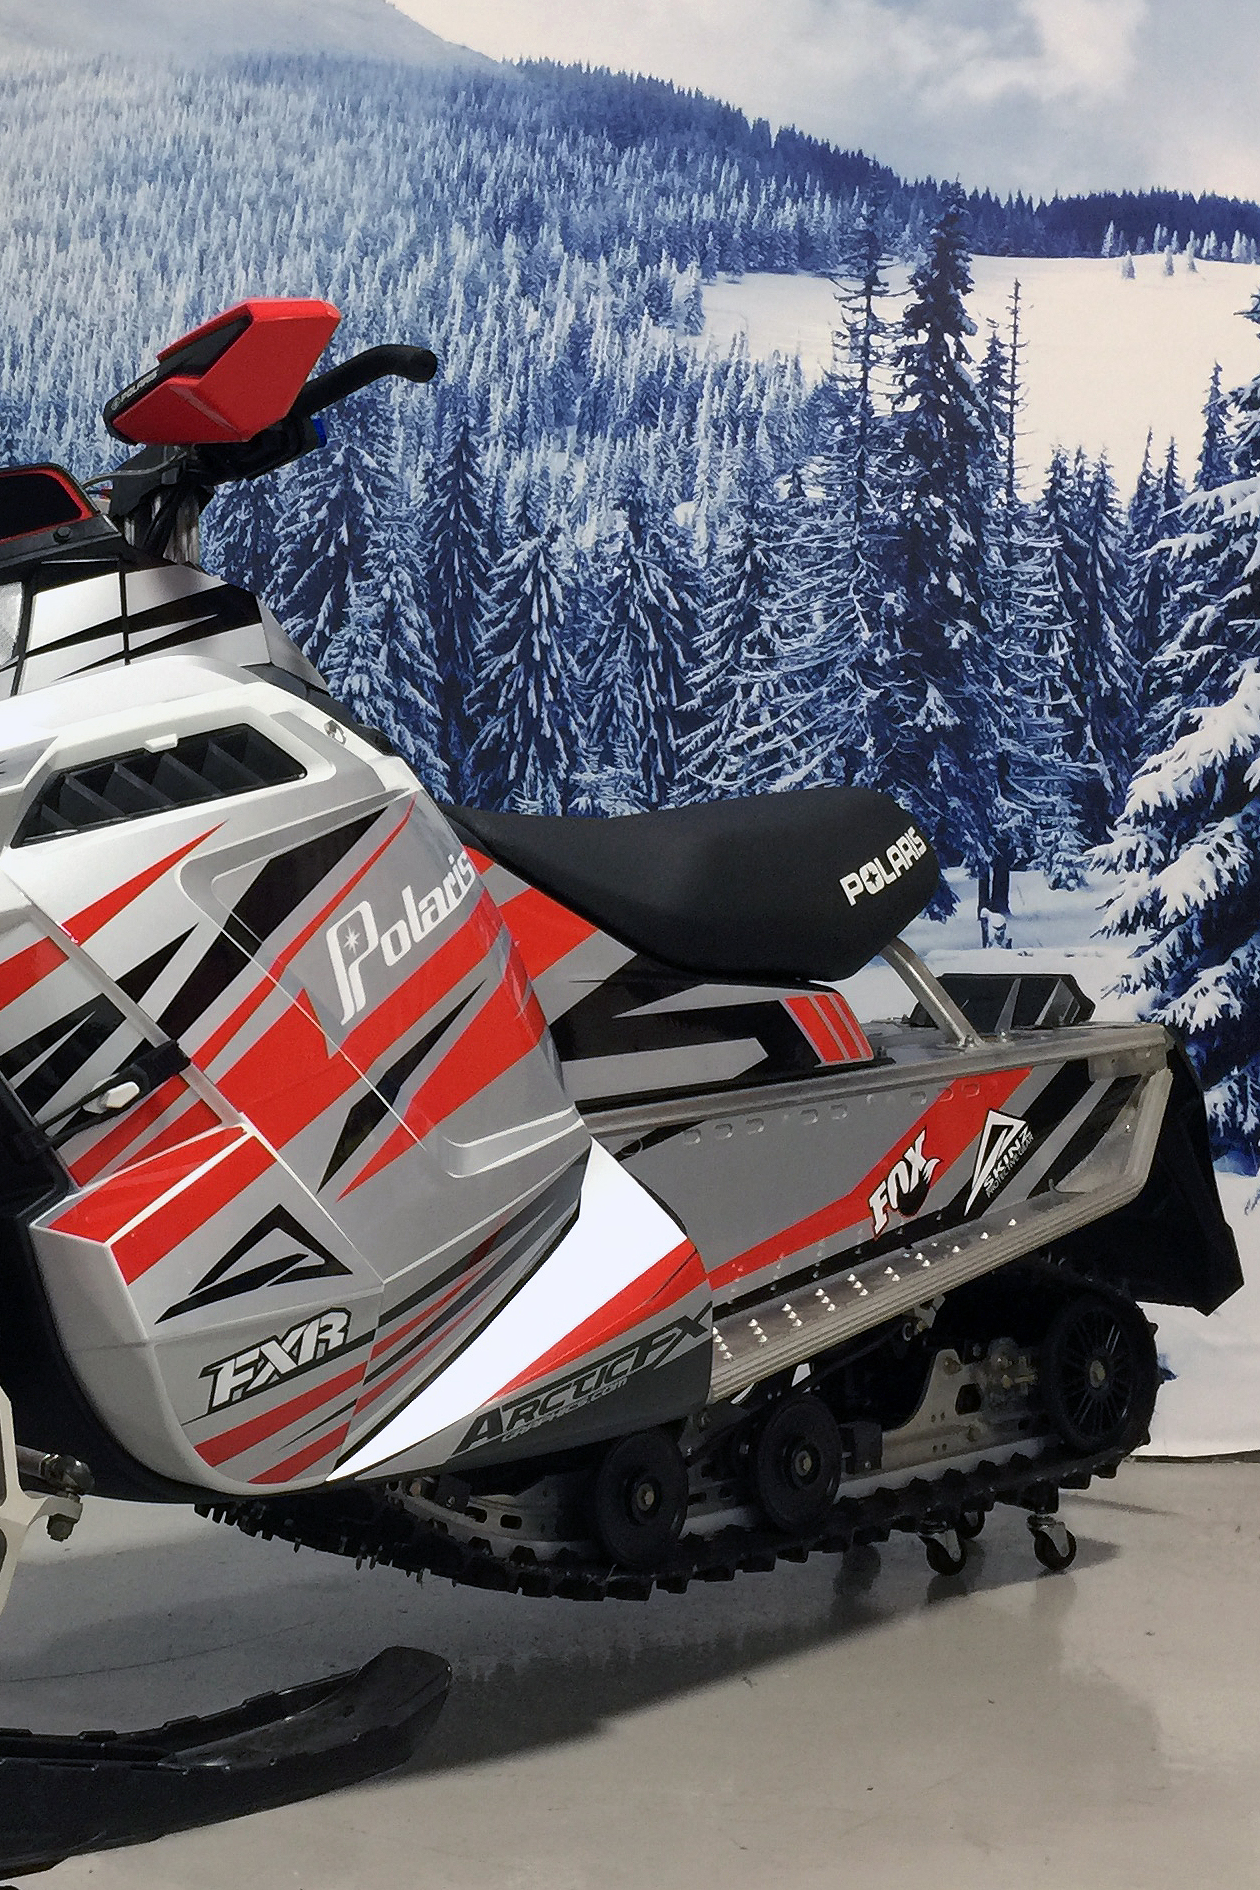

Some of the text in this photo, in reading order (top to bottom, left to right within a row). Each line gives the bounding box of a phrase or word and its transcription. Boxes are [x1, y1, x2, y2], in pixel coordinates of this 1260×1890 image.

[840, 826, 927, 906] POLARIS
[326, 850, 476, 1026] Polaris
[868, 1127, 928, 1236] FOX
[983, 1126, 1029, 1188] SKINZ
[203, 1308, 352, 1412] FXR
